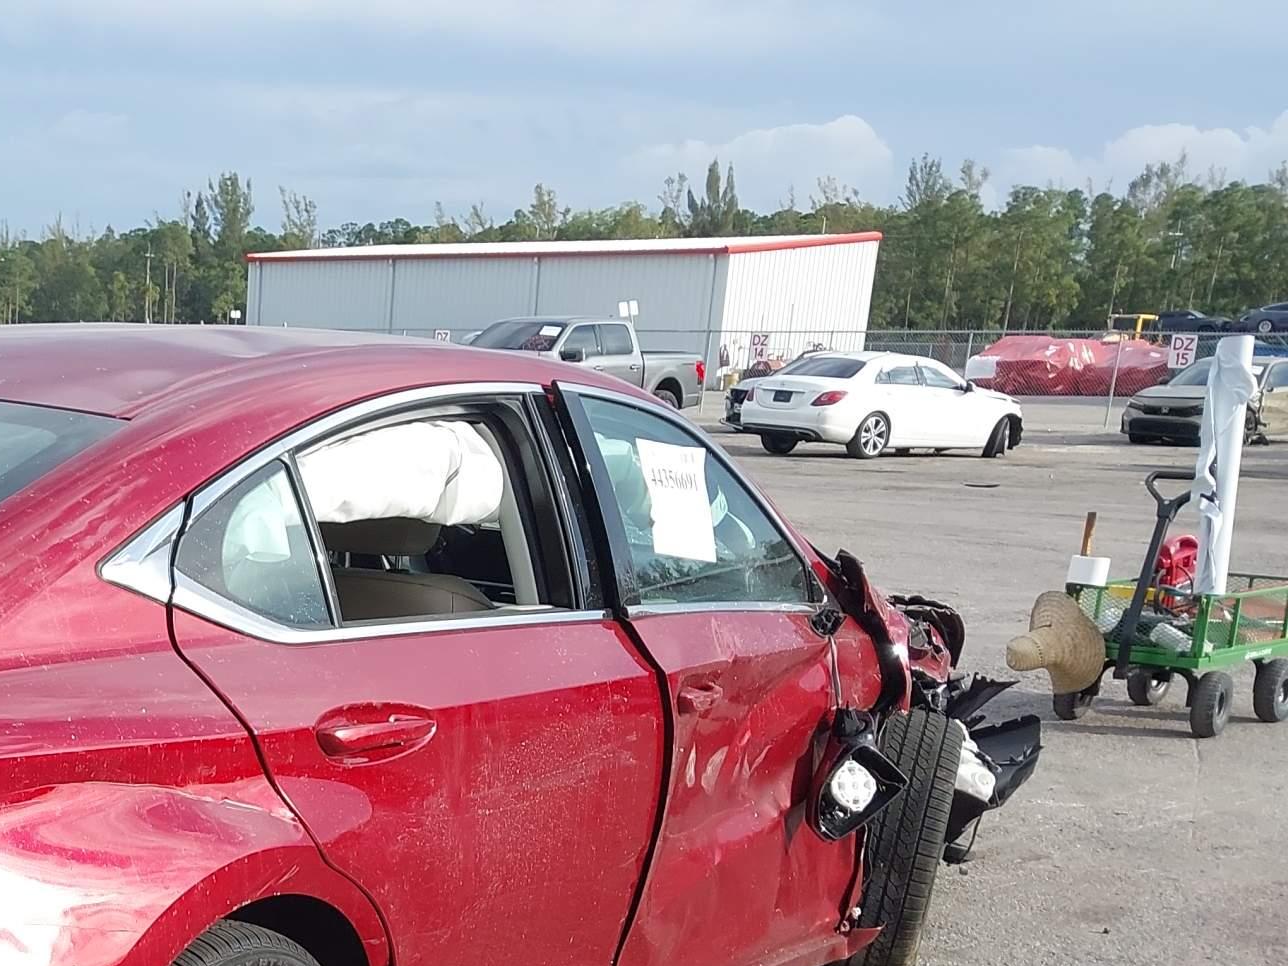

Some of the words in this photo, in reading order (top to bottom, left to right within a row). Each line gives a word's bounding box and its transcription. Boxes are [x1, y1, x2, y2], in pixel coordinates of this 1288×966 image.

[752, 334, 769, 346] DZ
[1173, 336, 1196, 352] DZ
[754, 347, 765, 359] 14
[1175, 352, 1189, 366] 15
[650, 467, 699, 492] 44356691
